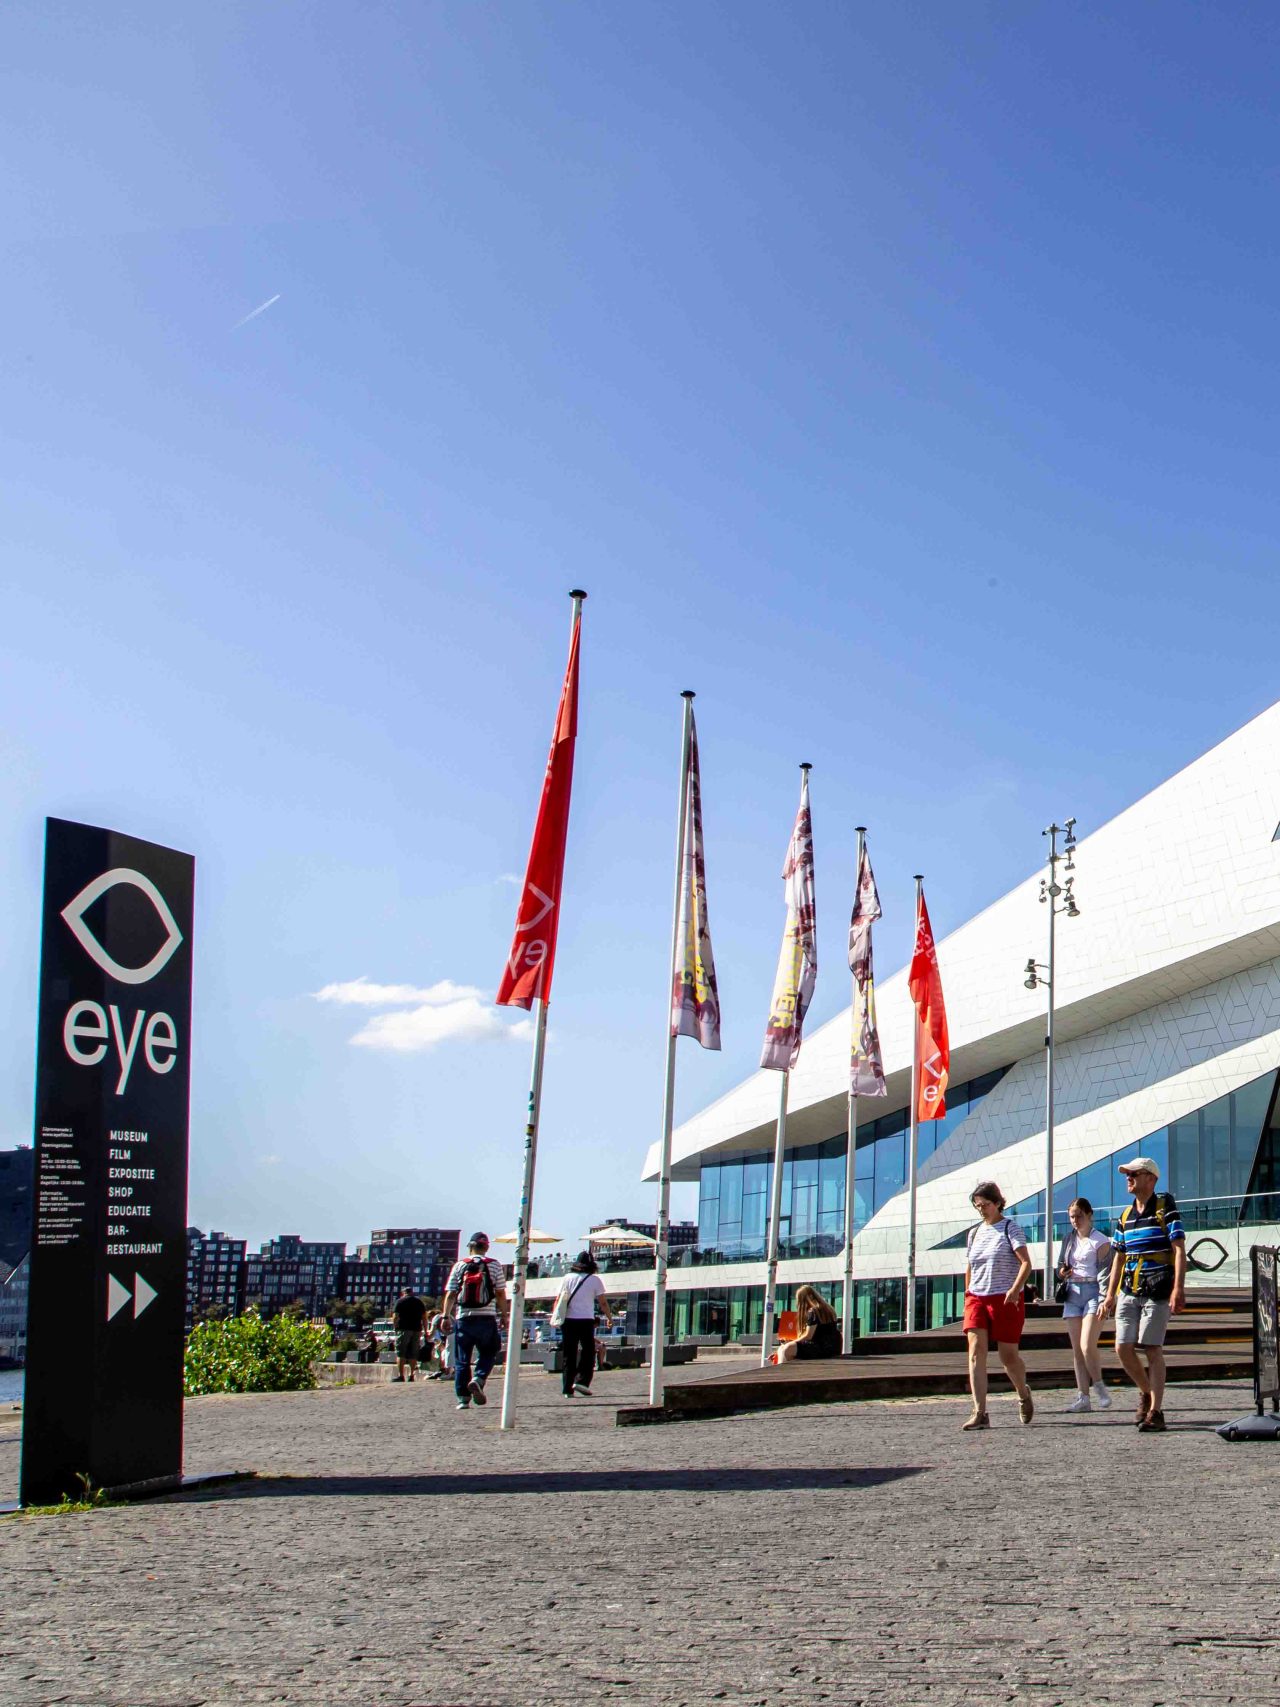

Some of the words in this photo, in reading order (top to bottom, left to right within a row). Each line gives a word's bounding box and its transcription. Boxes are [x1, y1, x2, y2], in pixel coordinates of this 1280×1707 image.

[63, 1000, 178, 1095] eye
[110, 1130, 148, 1142] MUSEUM
[109, 1149, 131, 1160] FILM
[109, 1168, 155, 1179] EXPOSITIE
[108, 1187, 133, 1197] SHOP
[108, 1206, 151, 1216] EDUCATIE
[107, 1225, 129, 1236] BAR-
[106, 1243, 163, 1255] RESTAURANT
